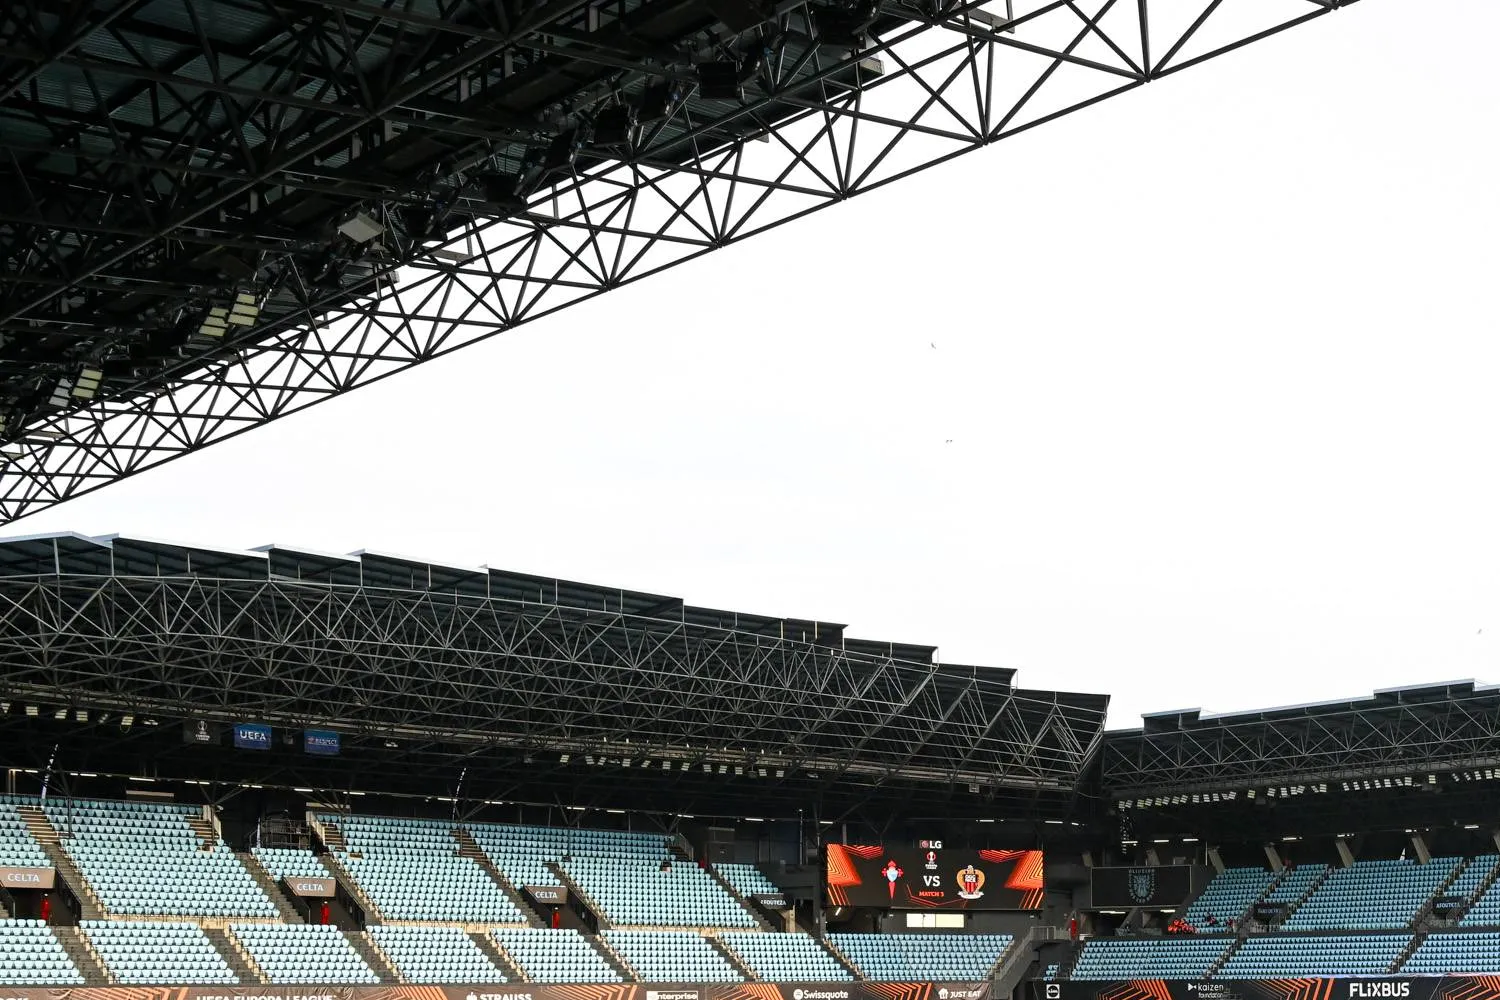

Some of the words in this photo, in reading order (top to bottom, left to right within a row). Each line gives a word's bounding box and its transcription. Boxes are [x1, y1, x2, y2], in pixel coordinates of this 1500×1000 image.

[239, 730, 266, 741] UEFA
[929, 840, 942, 849] LG
[7, 873, 40, 882] CELTA
[923, 875, 941, 887] VS
[296, 883, 324, 891] CELTA
[535, 891, 558, 899] CELTA
[1198, 982, 1224, 991] kaizen
[803, 989, 849, 1000] Swissquote
